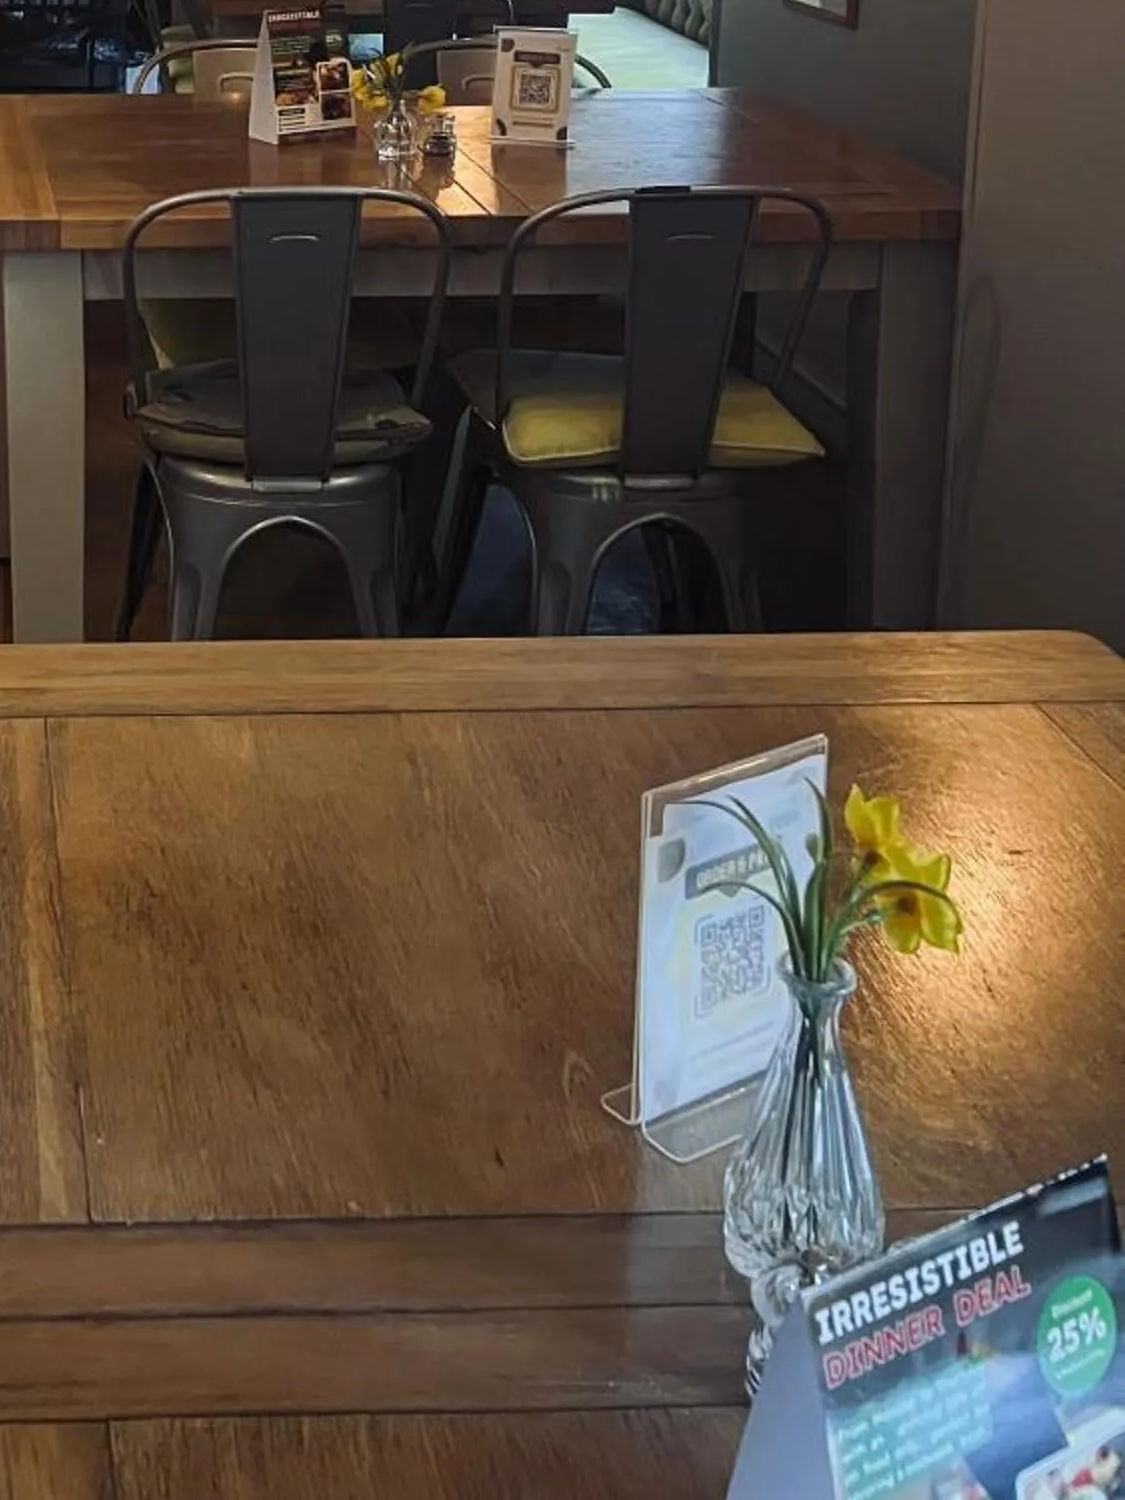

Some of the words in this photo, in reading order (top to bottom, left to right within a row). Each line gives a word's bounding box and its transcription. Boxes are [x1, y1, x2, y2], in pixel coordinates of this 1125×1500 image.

[814, 1221, 1024, 1345] IRRESISTIBLE
[823, 1304, 946, 1390] DINNER
[954, 1266, 1032, 1328] DEAL
[1047, 1305, 1107, 1363] 25%
